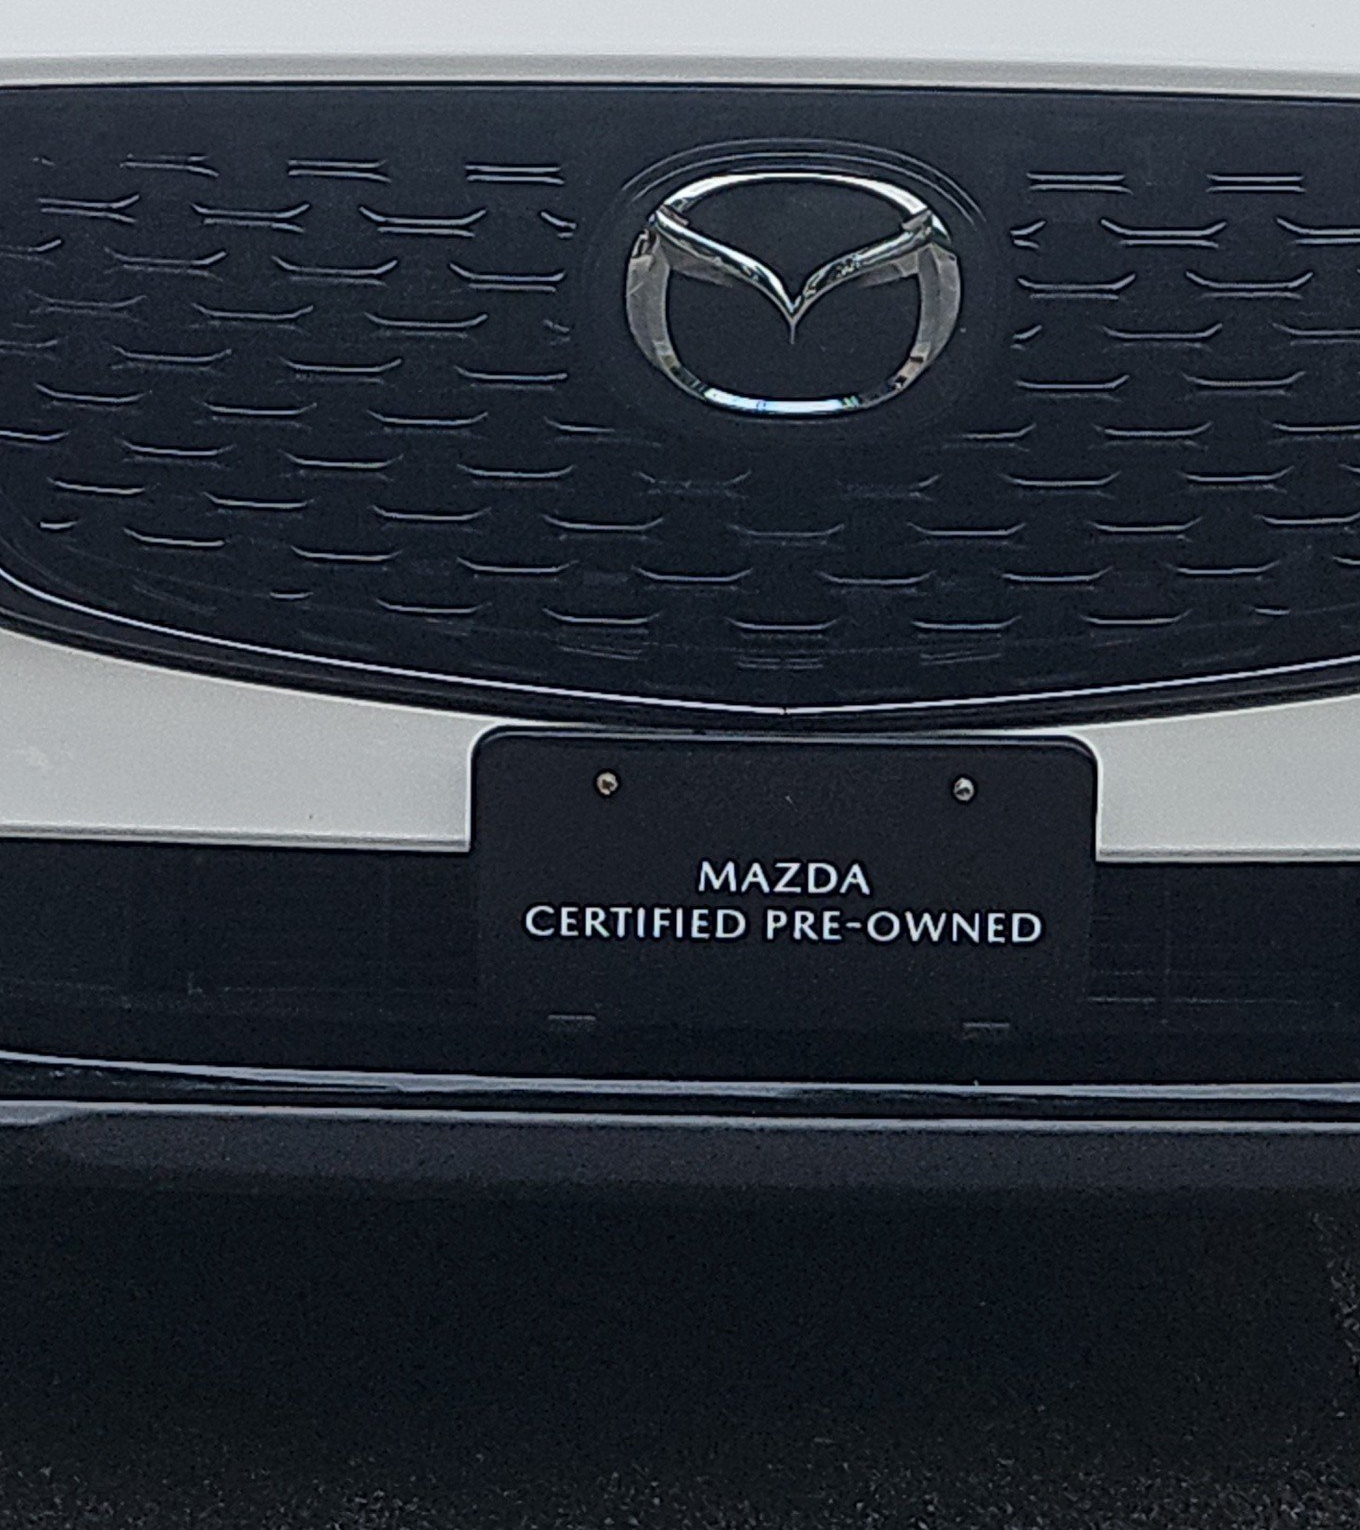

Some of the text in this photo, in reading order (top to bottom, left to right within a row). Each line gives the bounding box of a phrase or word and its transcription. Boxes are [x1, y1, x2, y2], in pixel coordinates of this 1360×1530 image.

[697, 860, 871, 895] MAZDA
[524, 906, 1042, 944] CERTIFIED PRE-OWNED
